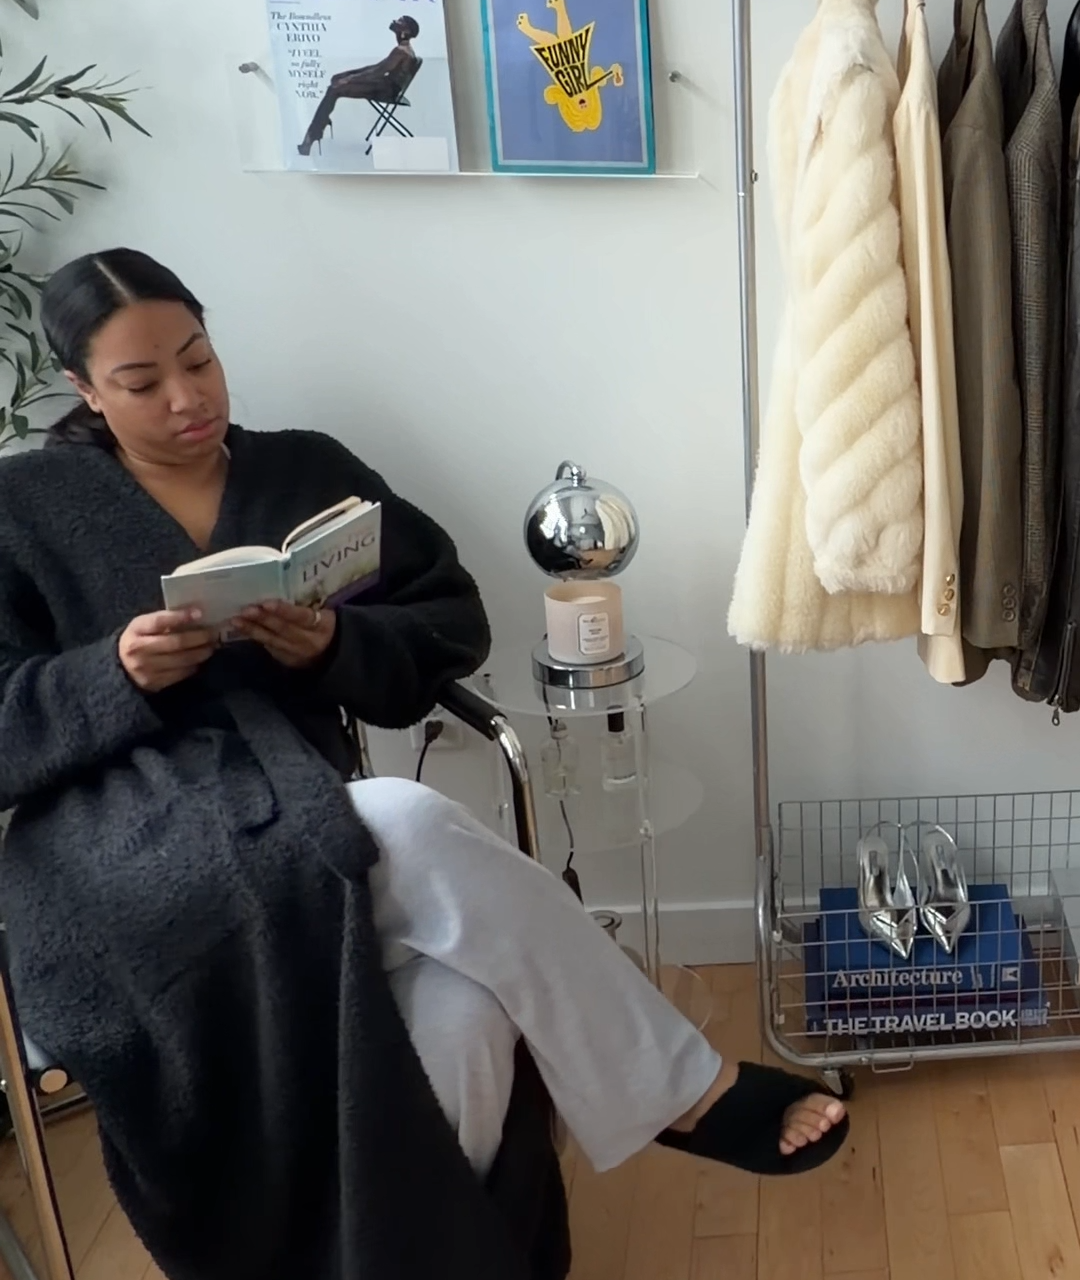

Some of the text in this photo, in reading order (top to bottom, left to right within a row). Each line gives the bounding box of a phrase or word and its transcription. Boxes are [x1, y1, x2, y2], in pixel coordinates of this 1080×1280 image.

[276, 22, 327, 32] CYNTHIA
[286, 33, 321, 43] ERIVO
[534, 26, 591, 72] FUNNY
[288, 70, 327, 79] MYSELF
[303, 531, 375, 583] LIVING
[832, 968, 964, 989] Architecture
[824, 1017, 868, 1036] THE
[868, 1013, 953, 1034] TRAVEL
[956, 1009, 1017, 1030] BOOK
